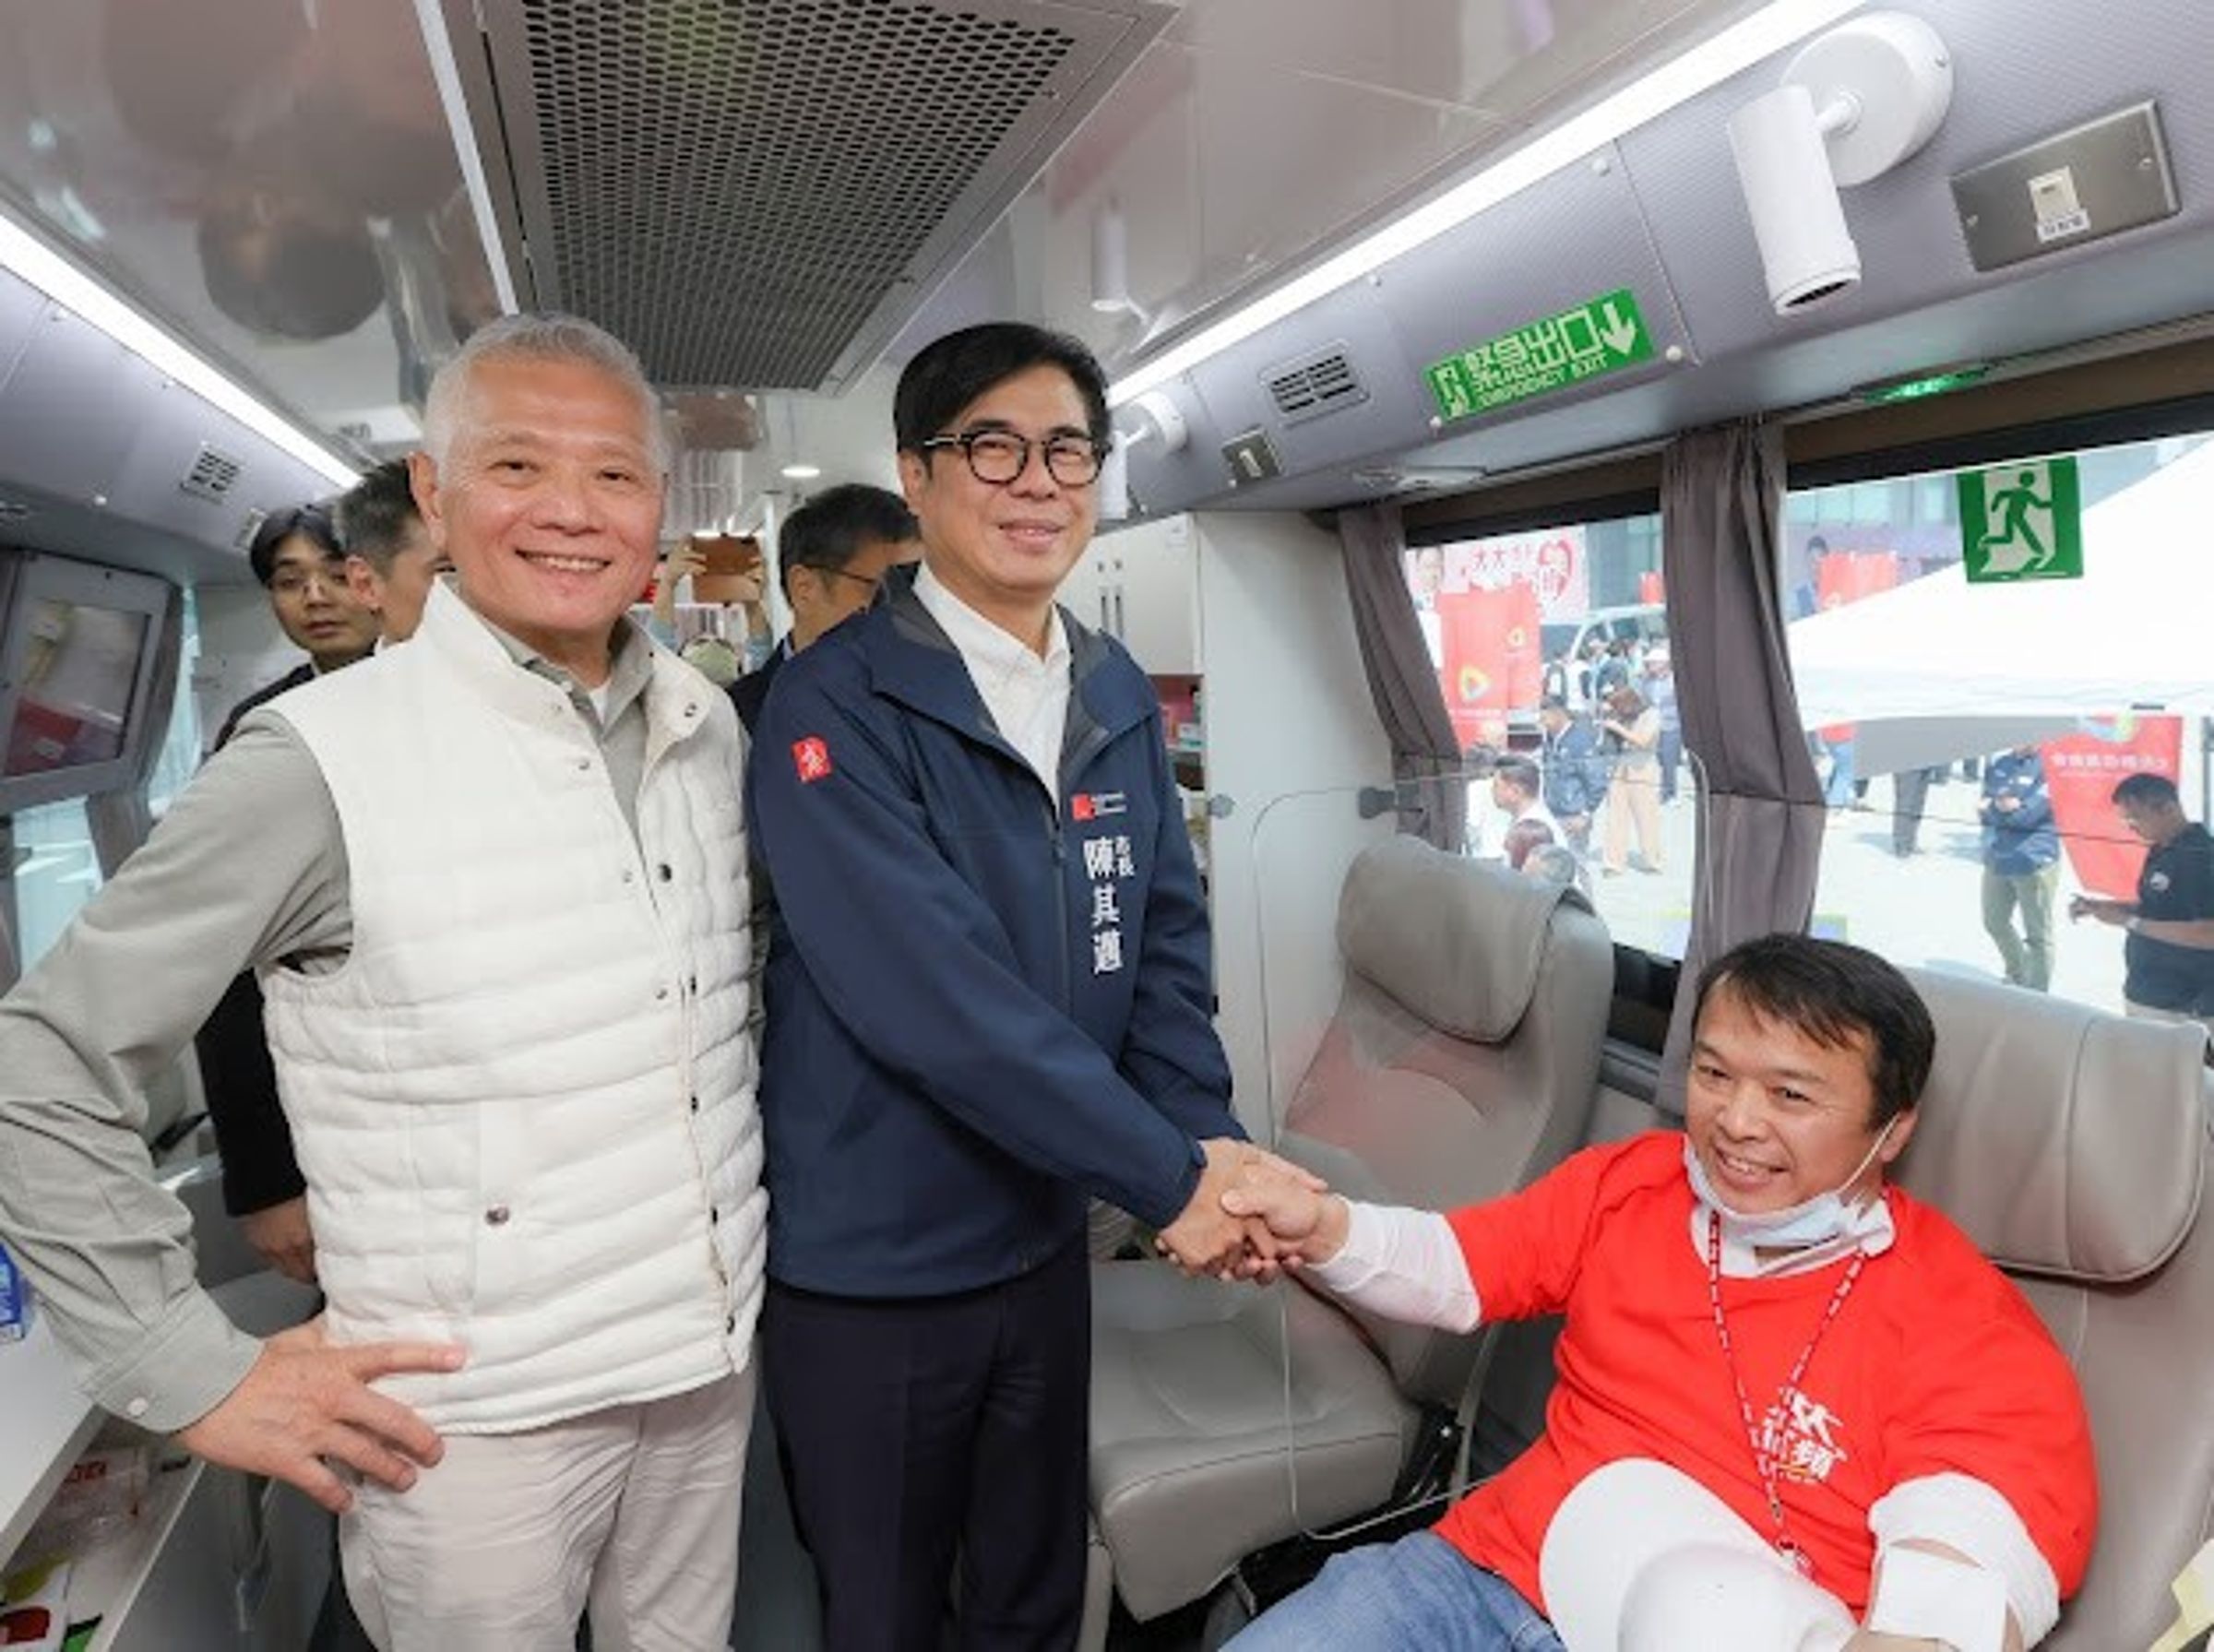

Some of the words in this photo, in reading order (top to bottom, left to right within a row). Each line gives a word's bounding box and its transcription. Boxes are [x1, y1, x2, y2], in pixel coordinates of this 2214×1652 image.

[1465, 309, 1604, 394] 緊急出口
[1571, 352, 1608, 378] EXIT
[1083, 836, 1124, 975] 陳其邁
